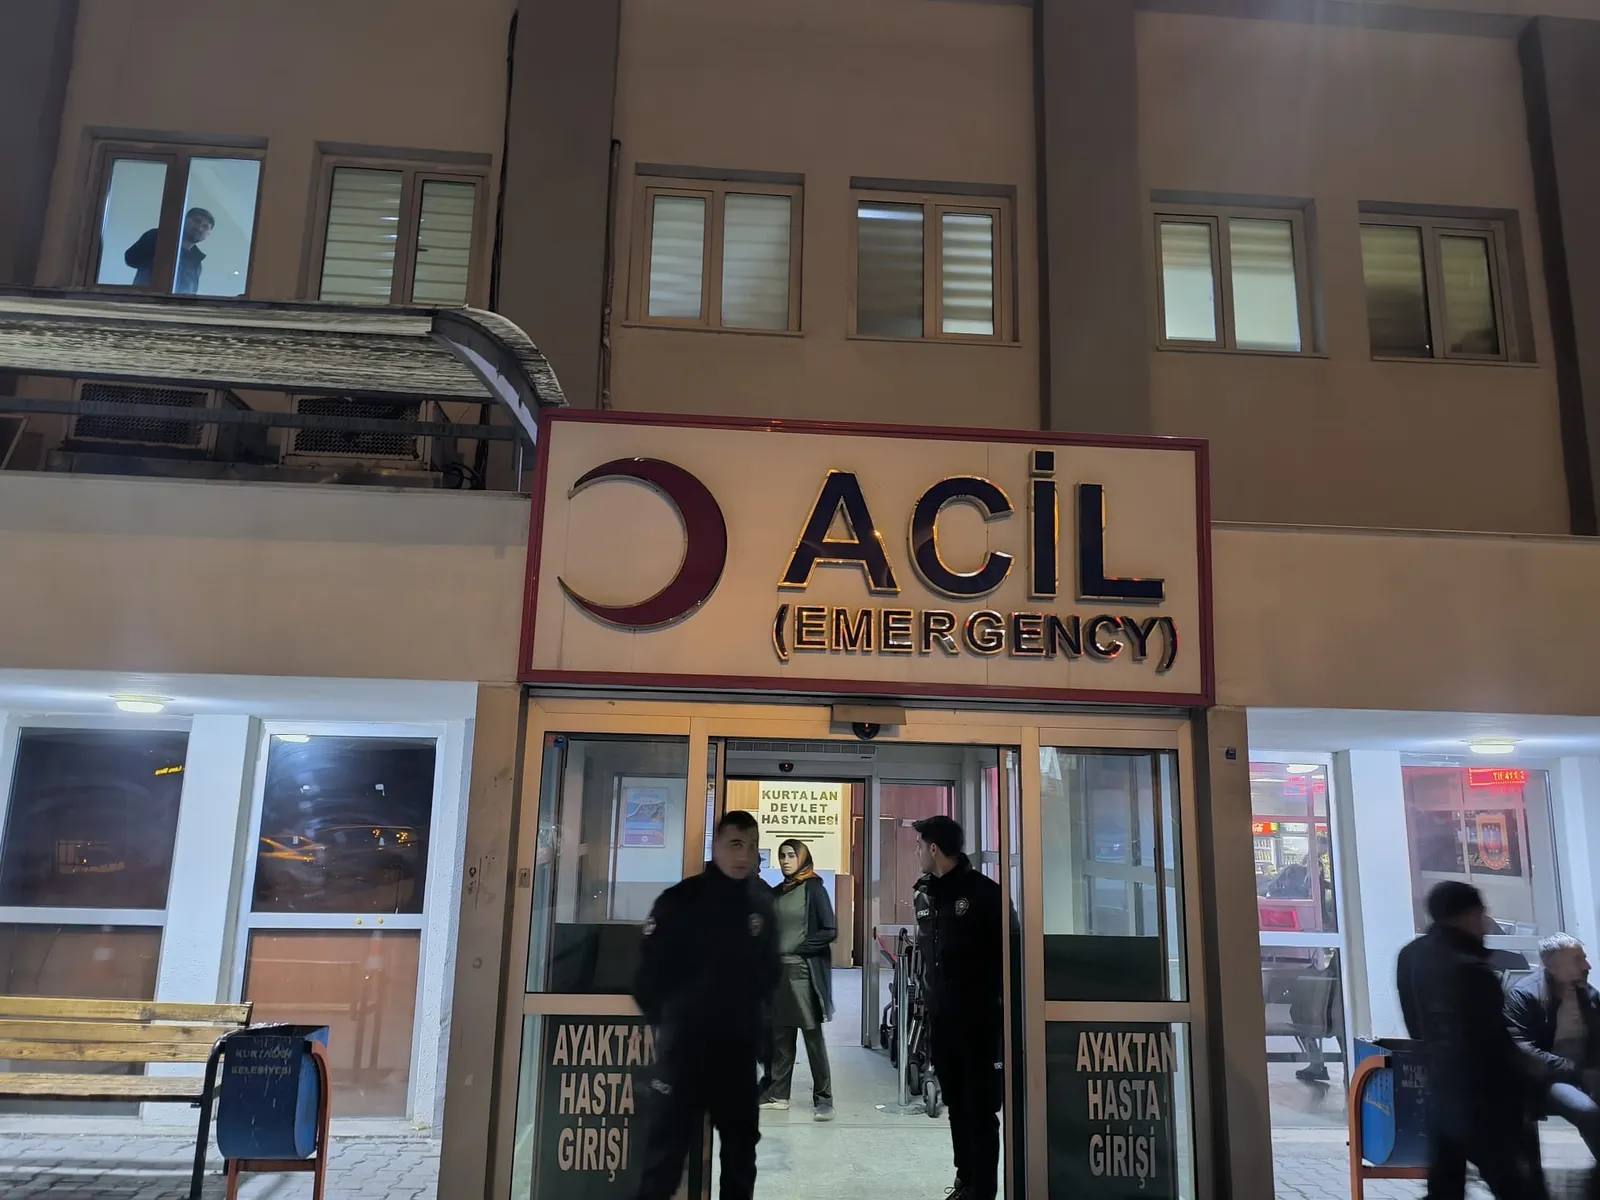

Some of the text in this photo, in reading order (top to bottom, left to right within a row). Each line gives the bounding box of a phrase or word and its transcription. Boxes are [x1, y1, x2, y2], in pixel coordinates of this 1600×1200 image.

[777, 449, 1166, 604] ACİL
[772, 602, 1179, 672] (EMERGENCY)
[762, 790, 838, 801] KURTALAN
[770, 802, 828, 813] DEVLET
[761, 813, 839, 825] HASTANESİ
[552, 1024, 661, 1067] AYAKTAN
[1076, 1031, 1179, 1073] AYAKTAN
[559, 1072, 635, 1115] HASTA
[1087, 1079, 1161, 1121] HASTA
[557, 1116, 629, 1183] GİRİŞİ
[1089, 1123, 1156, 1190] GİRİŞİ
